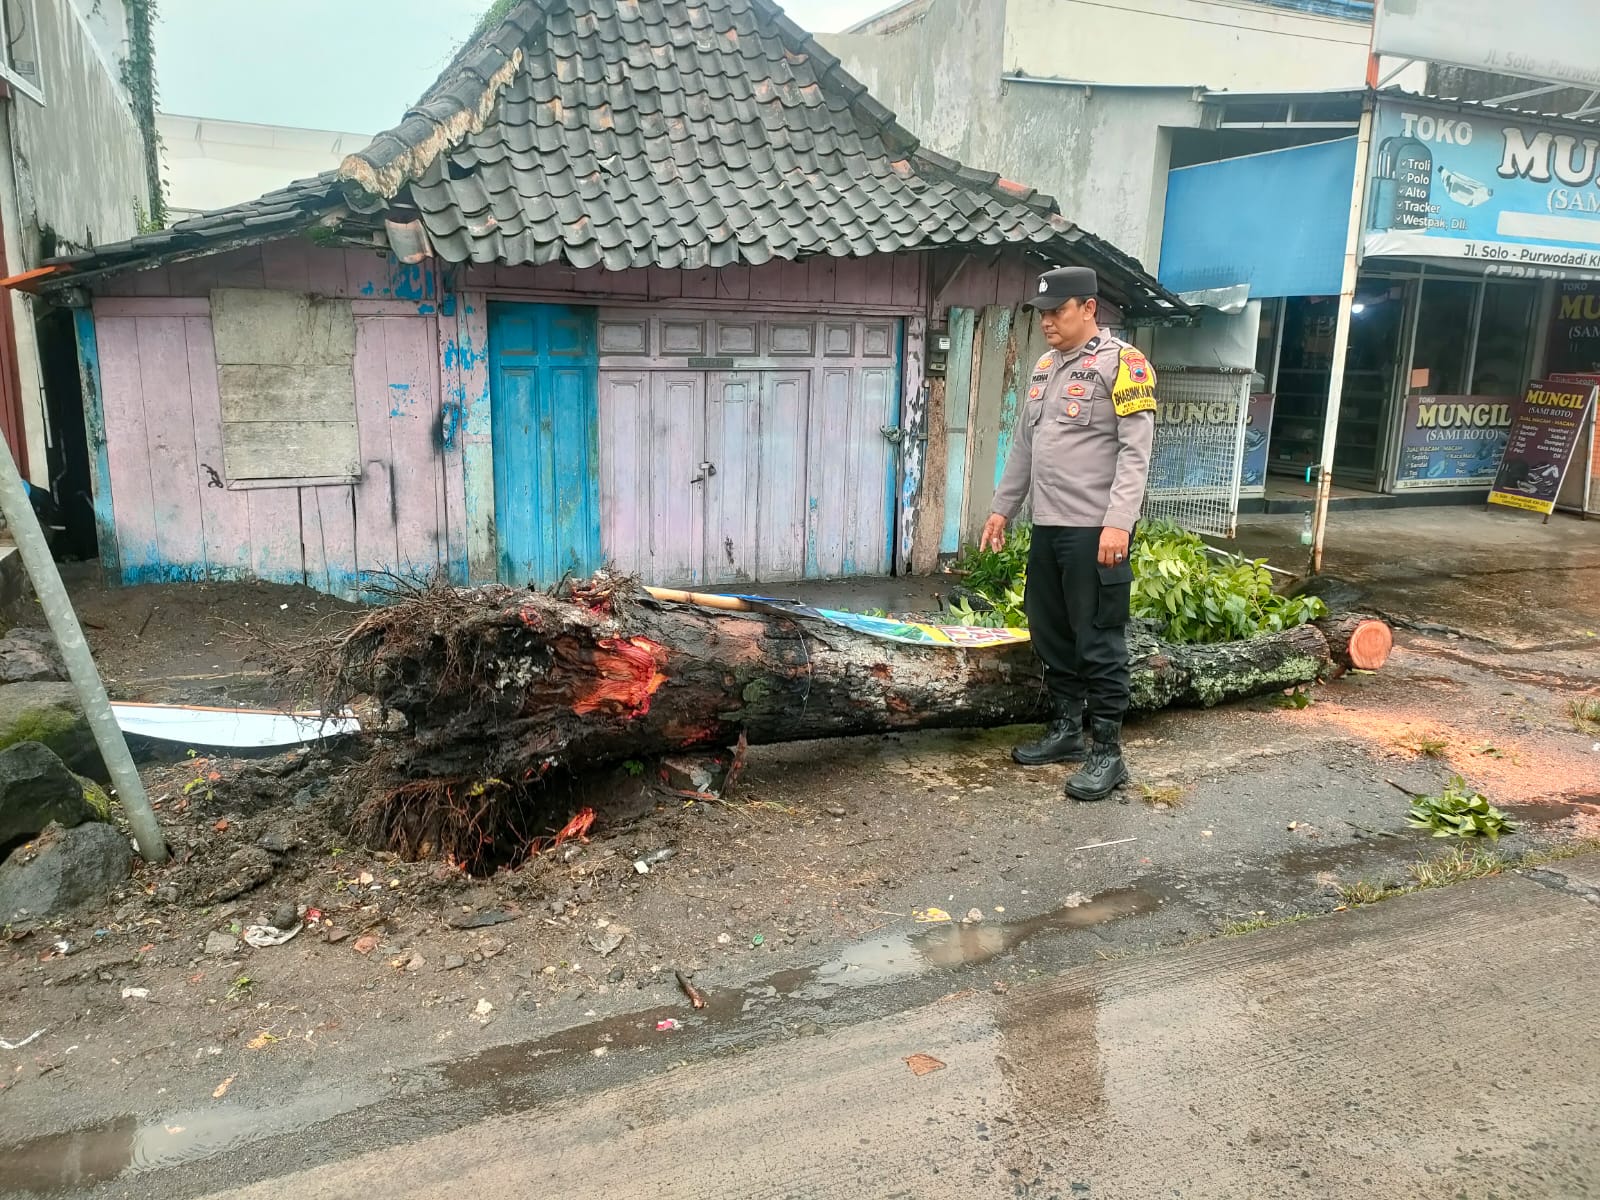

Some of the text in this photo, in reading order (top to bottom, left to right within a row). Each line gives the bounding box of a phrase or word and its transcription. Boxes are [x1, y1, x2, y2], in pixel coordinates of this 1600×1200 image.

[1504, 51, 1536, 71] Solo
[1401, 113, 1473, 146] TOKO
[1408, 159, 1431, 171] Troli
[1497, 127, 1600, 188] MU
[1407, 173, 1430, 185] Polo
[1405, 187, 1427, 199] Alto
[1404, 200, 1441, 214] Tracker
[1403, 214, 1449, 231] Westpak,
[1464, 244, 1478, 257] Jl.
[1482, 245, 1509, 259] Solo
[1520, 249, 1588, 265] Purwodadi
[1562, 282, 1588, 291] TOKO
[1070, 371, 1096, 380] POLRI
[1525, 389, 1585, 409] MUNGIL
[1416, 404, 1512, 428] MUNGIL
[1427, 429, 1498, 442] (SAMI ROTO)
